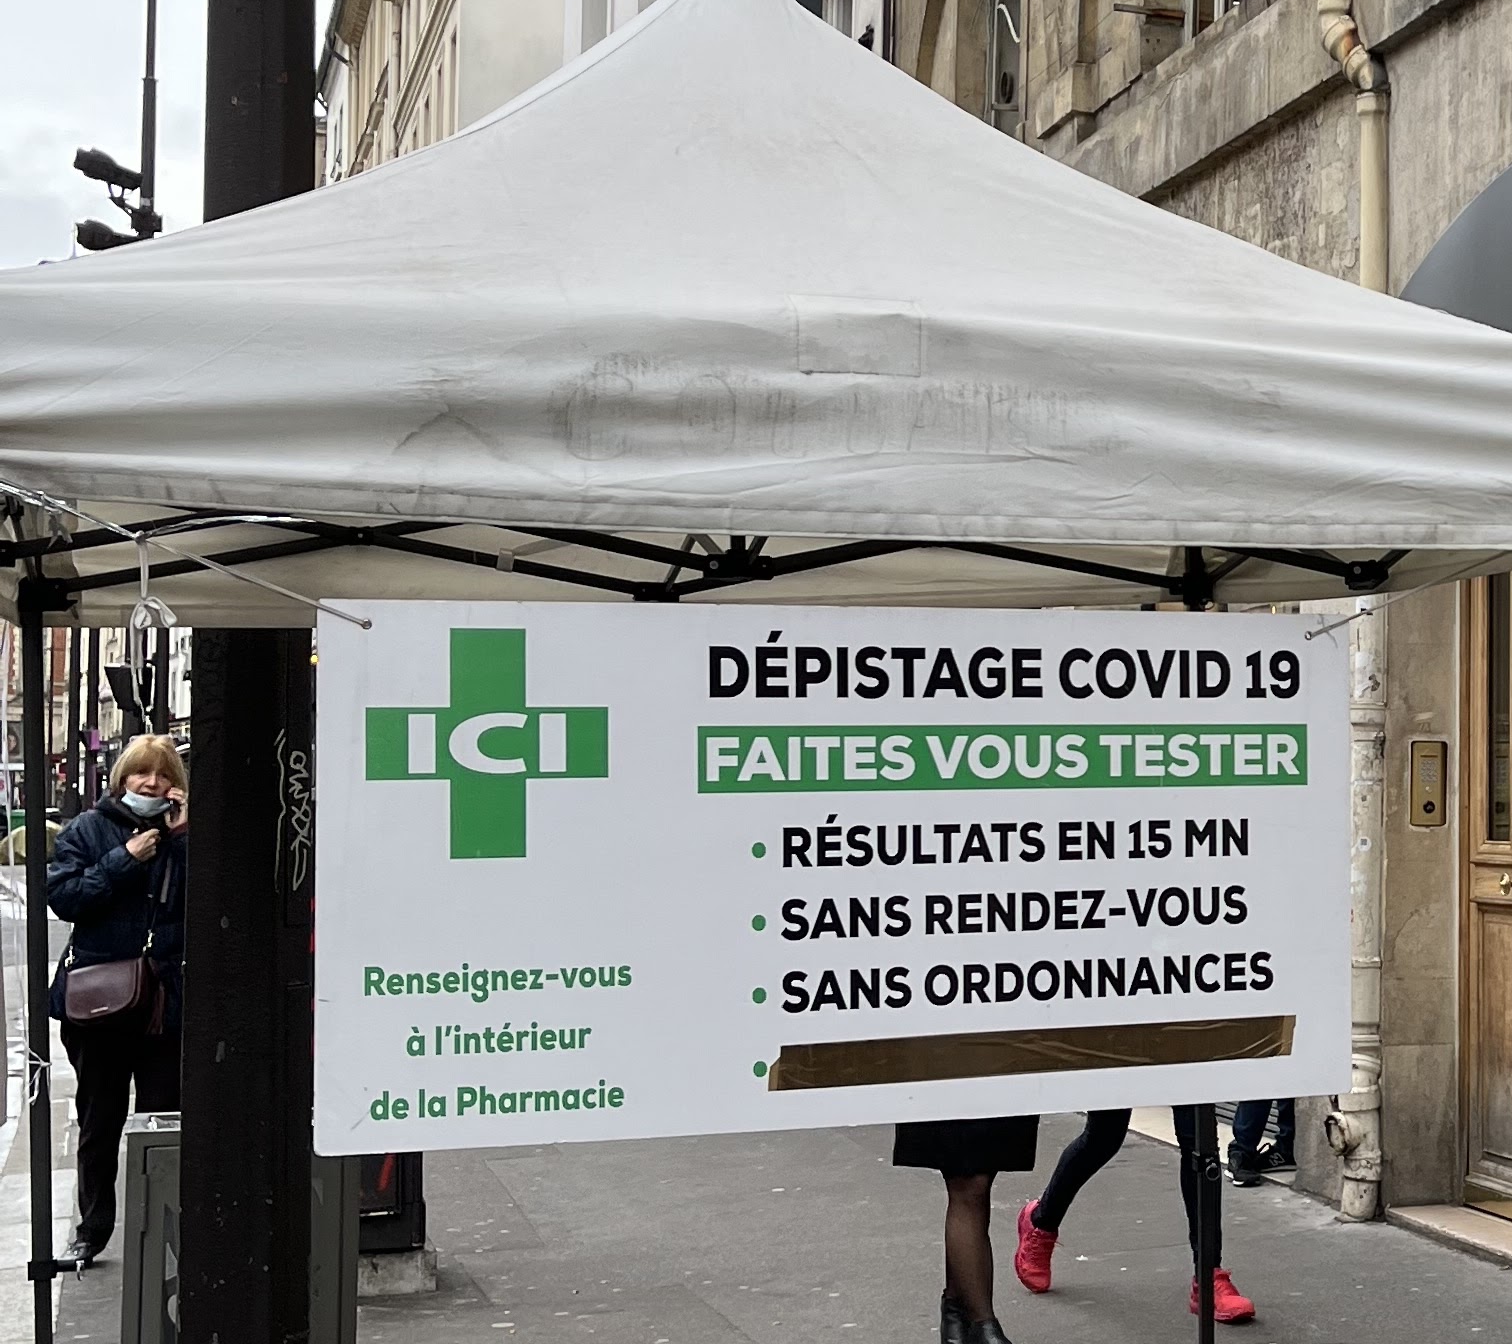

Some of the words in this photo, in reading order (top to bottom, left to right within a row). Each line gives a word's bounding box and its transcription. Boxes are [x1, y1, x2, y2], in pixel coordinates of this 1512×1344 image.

[708, 630, 1043, 700] DÉPISTAGE
[1057, 647, 1231, 700] COVID
[1245, 650, 1301, 699] 19
[407, 712, 568, 775] ICI
[705, 735, 916, 782] FAITES
[925, 734, 1089, 779] VOUS
[1099, 733, 1300, 777] TESTER
[781, 813, 1046, 868] RÉSULTATS
[1058, 820, 1115, 861] EN
[1128, 819, 1172, 859] 15
[1185, 818, 1249, 858] MN
[780, 895, 912, 942] SANS
[925, 885, 1248, 935] RENDEZ-VOUS
[364, 962, 632, 1003] Renseignez-vous
[780, 966, 912, 1014] SANS
[924, 951, 1274, 1006] ORDONNANCES
[406, 1025, 426, 1057] à
[435, 1021, 592, 1056] l'intérieur
[370, 1082, 410, 1121] de
[418, 1081, 448, 1119] la
[457, 1079, 625, 1117] Pharmacie
